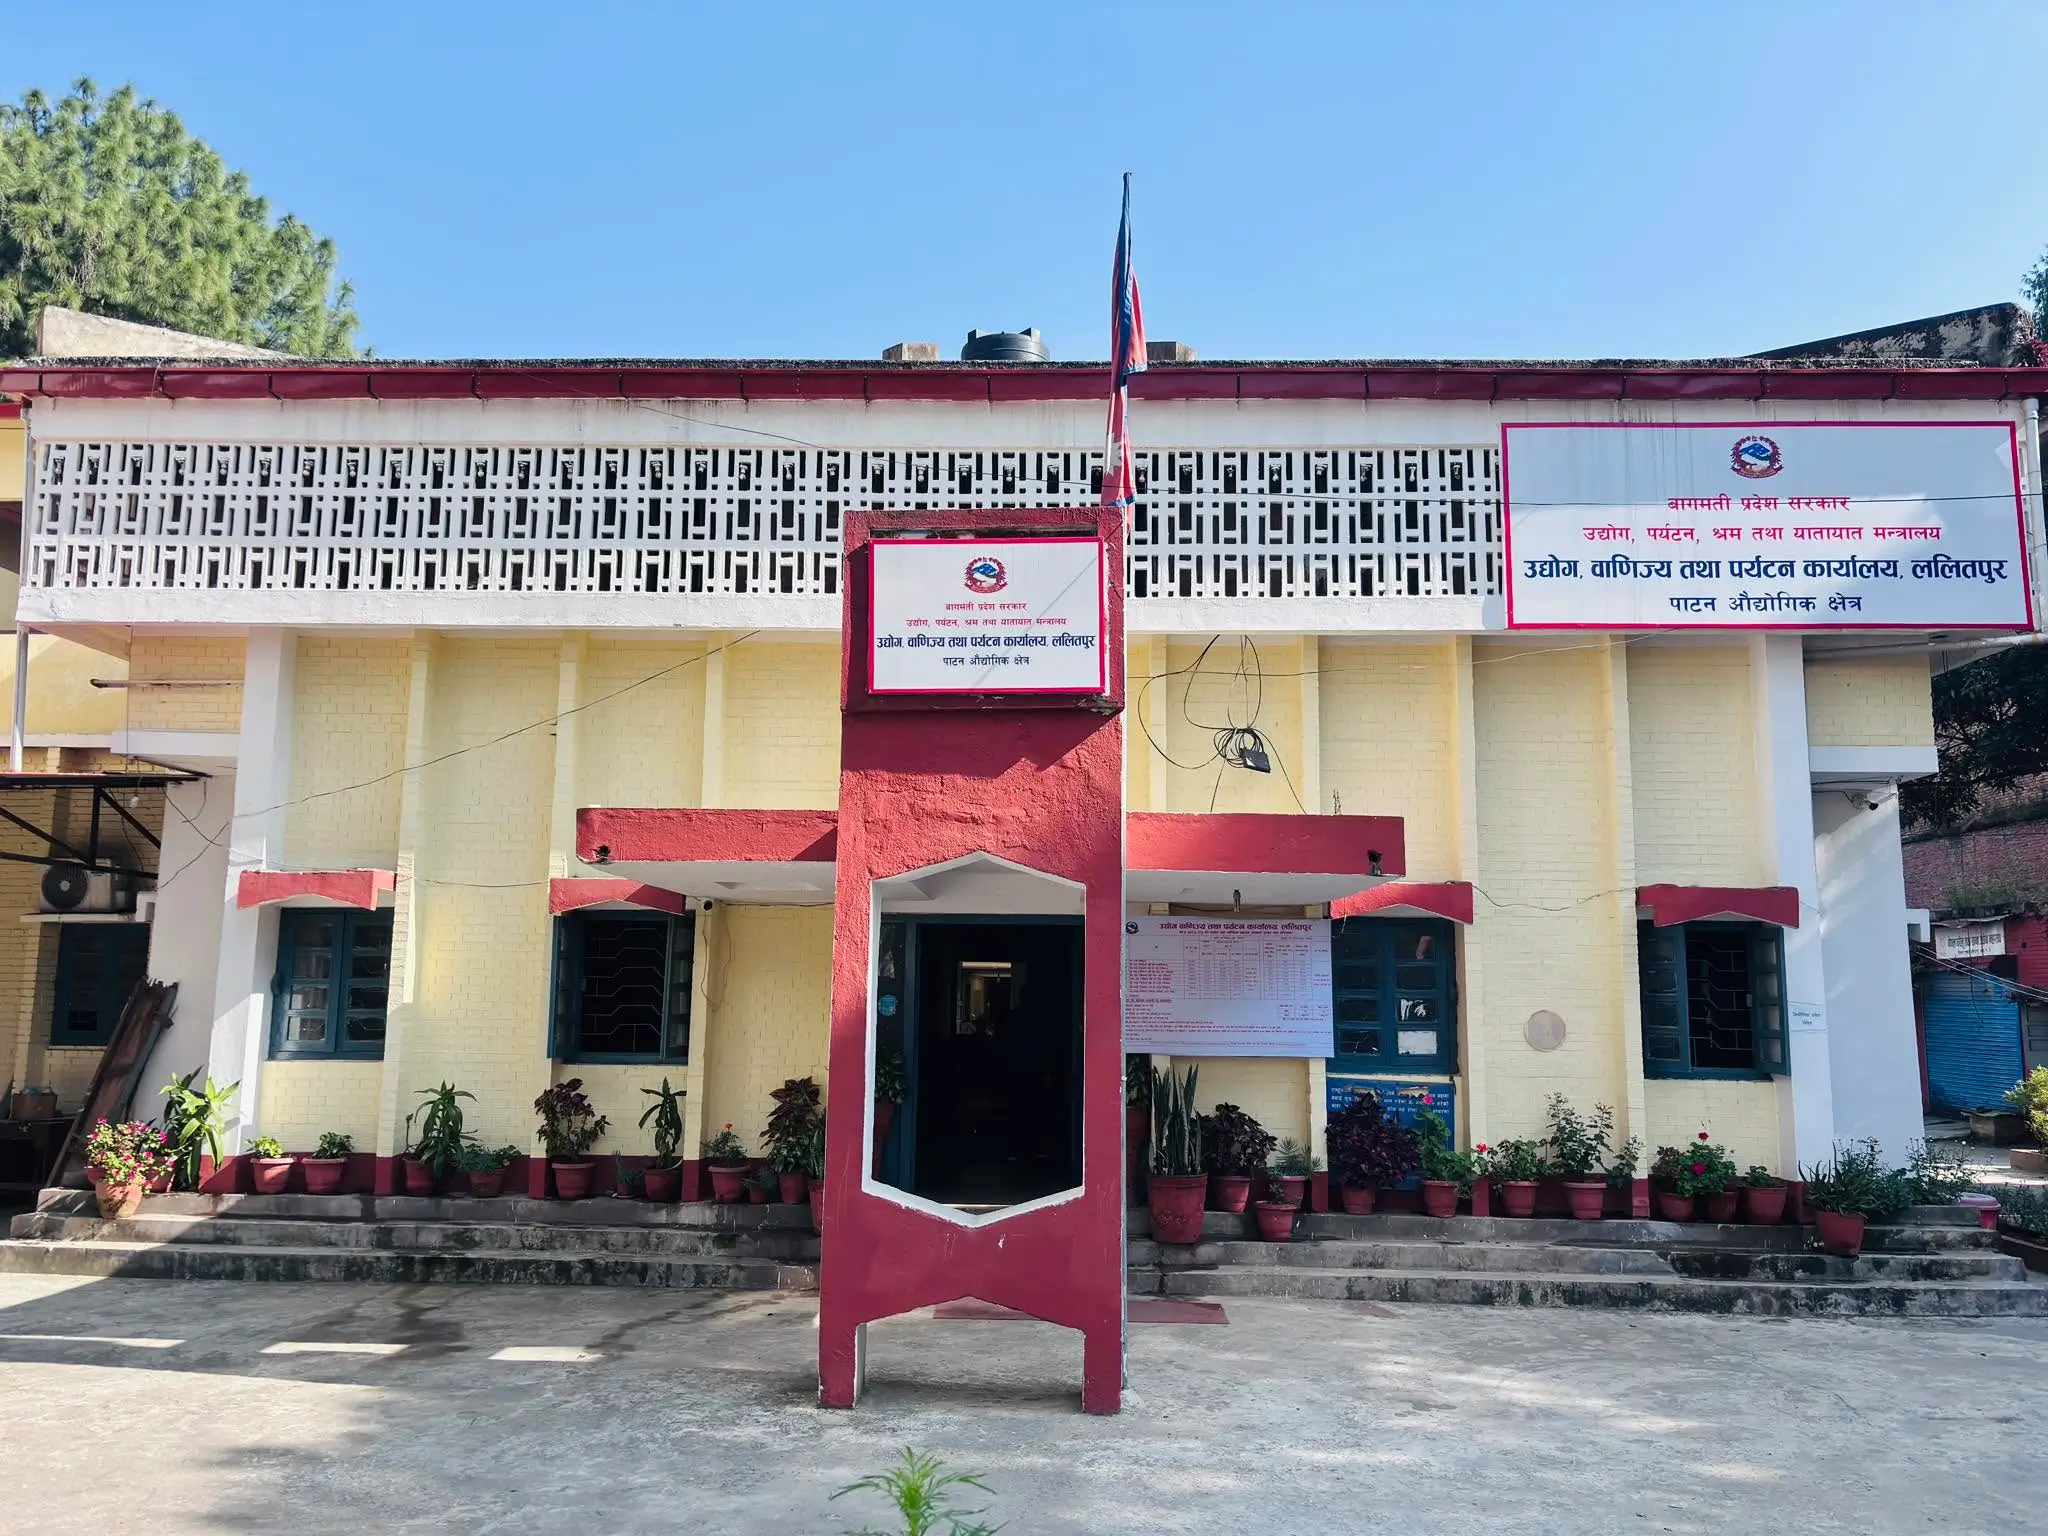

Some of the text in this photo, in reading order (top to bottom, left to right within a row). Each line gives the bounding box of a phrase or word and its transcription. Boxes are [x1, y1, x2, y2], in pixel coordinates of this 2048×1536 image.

[1668, 493, 1850, 511] बागमती प्रदेश सरकार
[1583, 524, 1941, 544] उद्योग, पर्यटन, श्रम तथा यातायात मन्त्रालय
[1523, 553, 2008, 584] उद्योग, वाणिज्य तथा पर्यटन कार्यालय, ललितपुर
[945, 601, 1027, 611] बागमती प्रदेश सरकार
[1670, 591, 1862, 612] पाटन औद्योगिक क्षेत्र
[906, 618, 930, 628] उद्योग,
[965, 619, 978, 627] श्रम
[982, 618, 996, 626] तथा
[1000, 618, 1032, 626] यातायात
[1036, 617, 1067, 626] मन्त्रालय
[907, 633, 945, 648] वाणिज्य
[948, 636, 967, 648] तथा
[970, 634, 1001, 648] पर्यटन
[1052, 632, 1096, 649] ललितपुर
[943, 653, 1030, 666] पाटन औद्योगिक क्षेत्र
